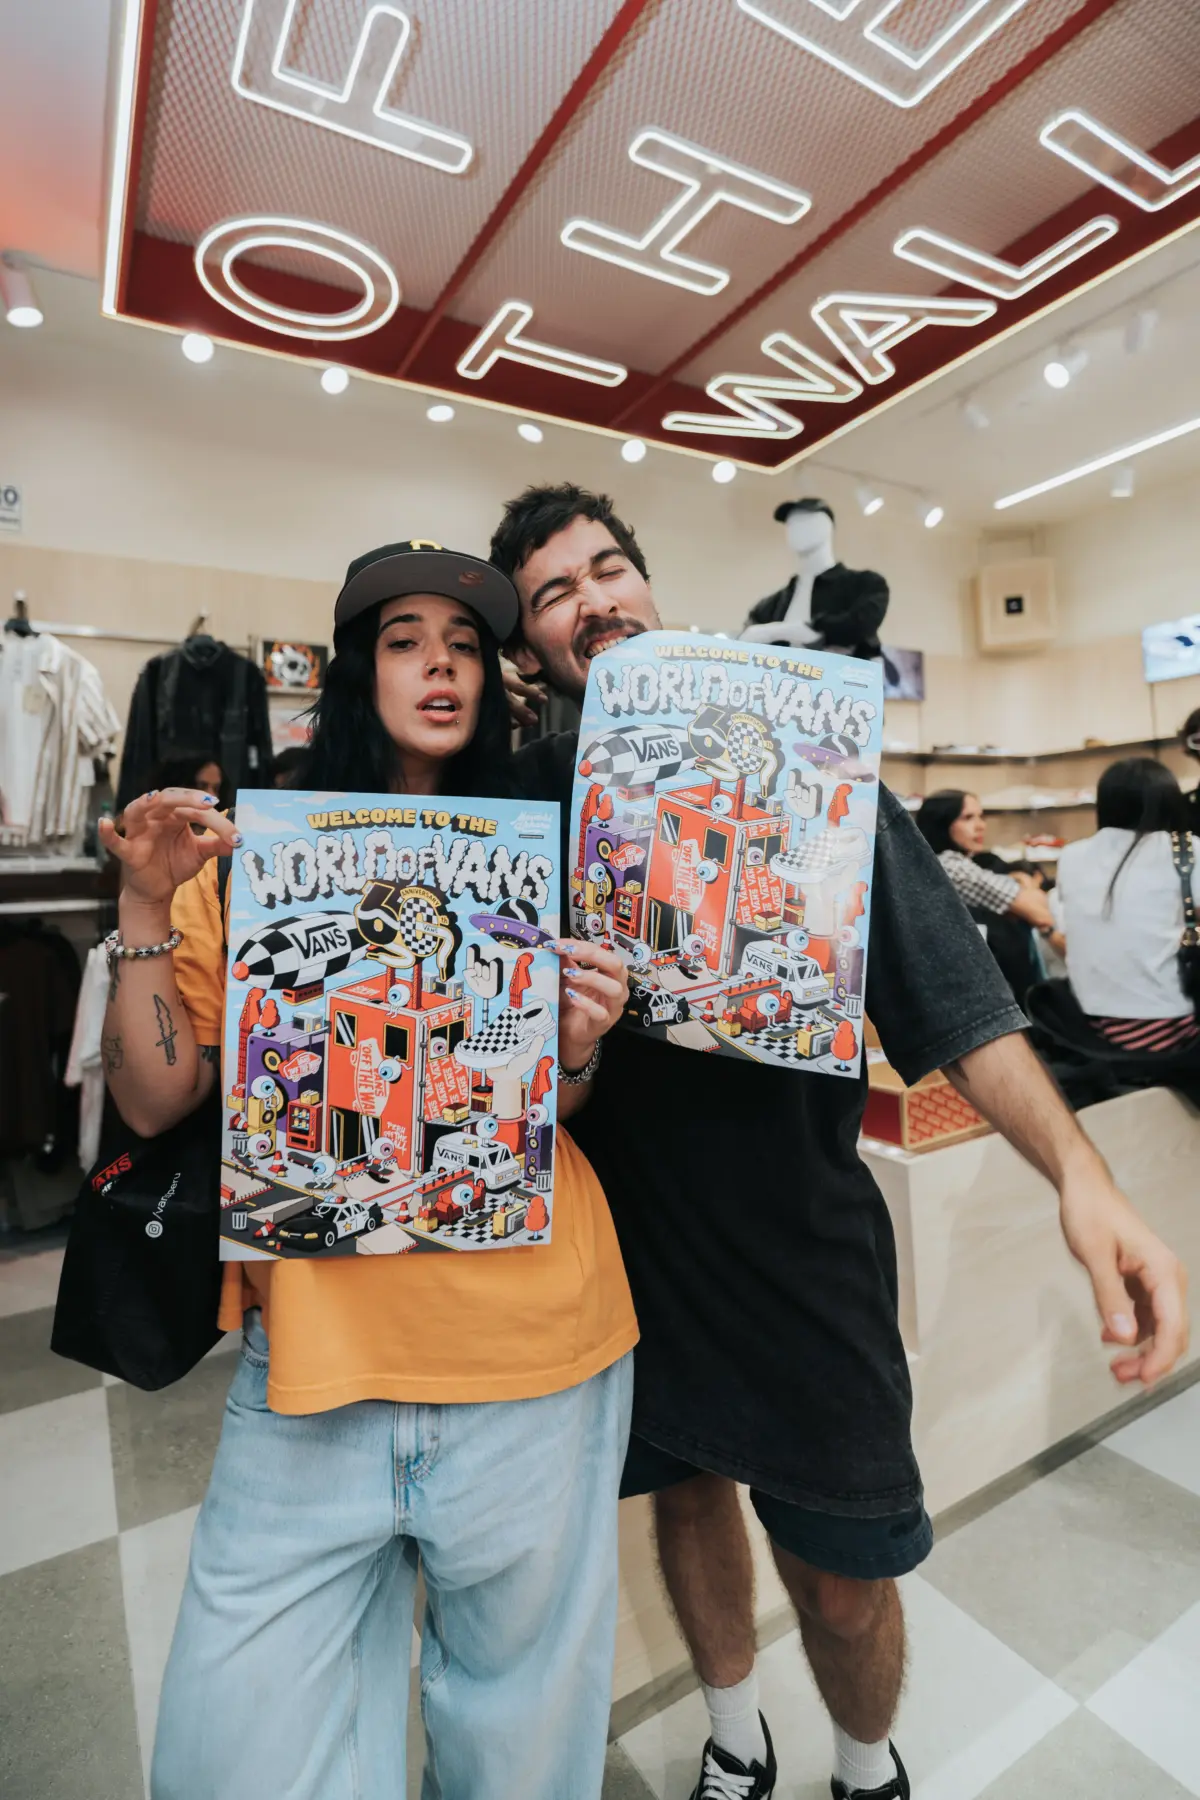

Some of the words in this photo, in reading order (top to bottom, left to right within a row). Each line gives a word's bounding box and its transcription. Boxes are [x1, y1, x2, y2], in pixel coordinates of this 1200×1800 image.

[662, 108, 1200, 441] WALL
[653, 645, 750, 664] WELCOME
[754, 652, 781, 668] TO
[786, 658, 824, 680] THE
[595, 662, 730, 715] WORLD
[729, 681, 767, 708] OF
[762, 672, 877, 747] VANS
[628, 734, 681, 764] VANS
[306, 808, 417, 830] WELCOME
[423, 809, 452, 828] TO
[457, 814, 498, 836] THE
[241, 830, 397, 908] WORLD
[396, 845, 437, 880] OF
[433, 833, 555, 910] VANS
[401, 887, 442, 906] ANNIVERSARY
[289, 922, 349, 961] VANS
[746, 951, 773, 973] VANS
[91, 1151, 133, 1192] ANS
[436, 1146, 465, 1164] VANS
